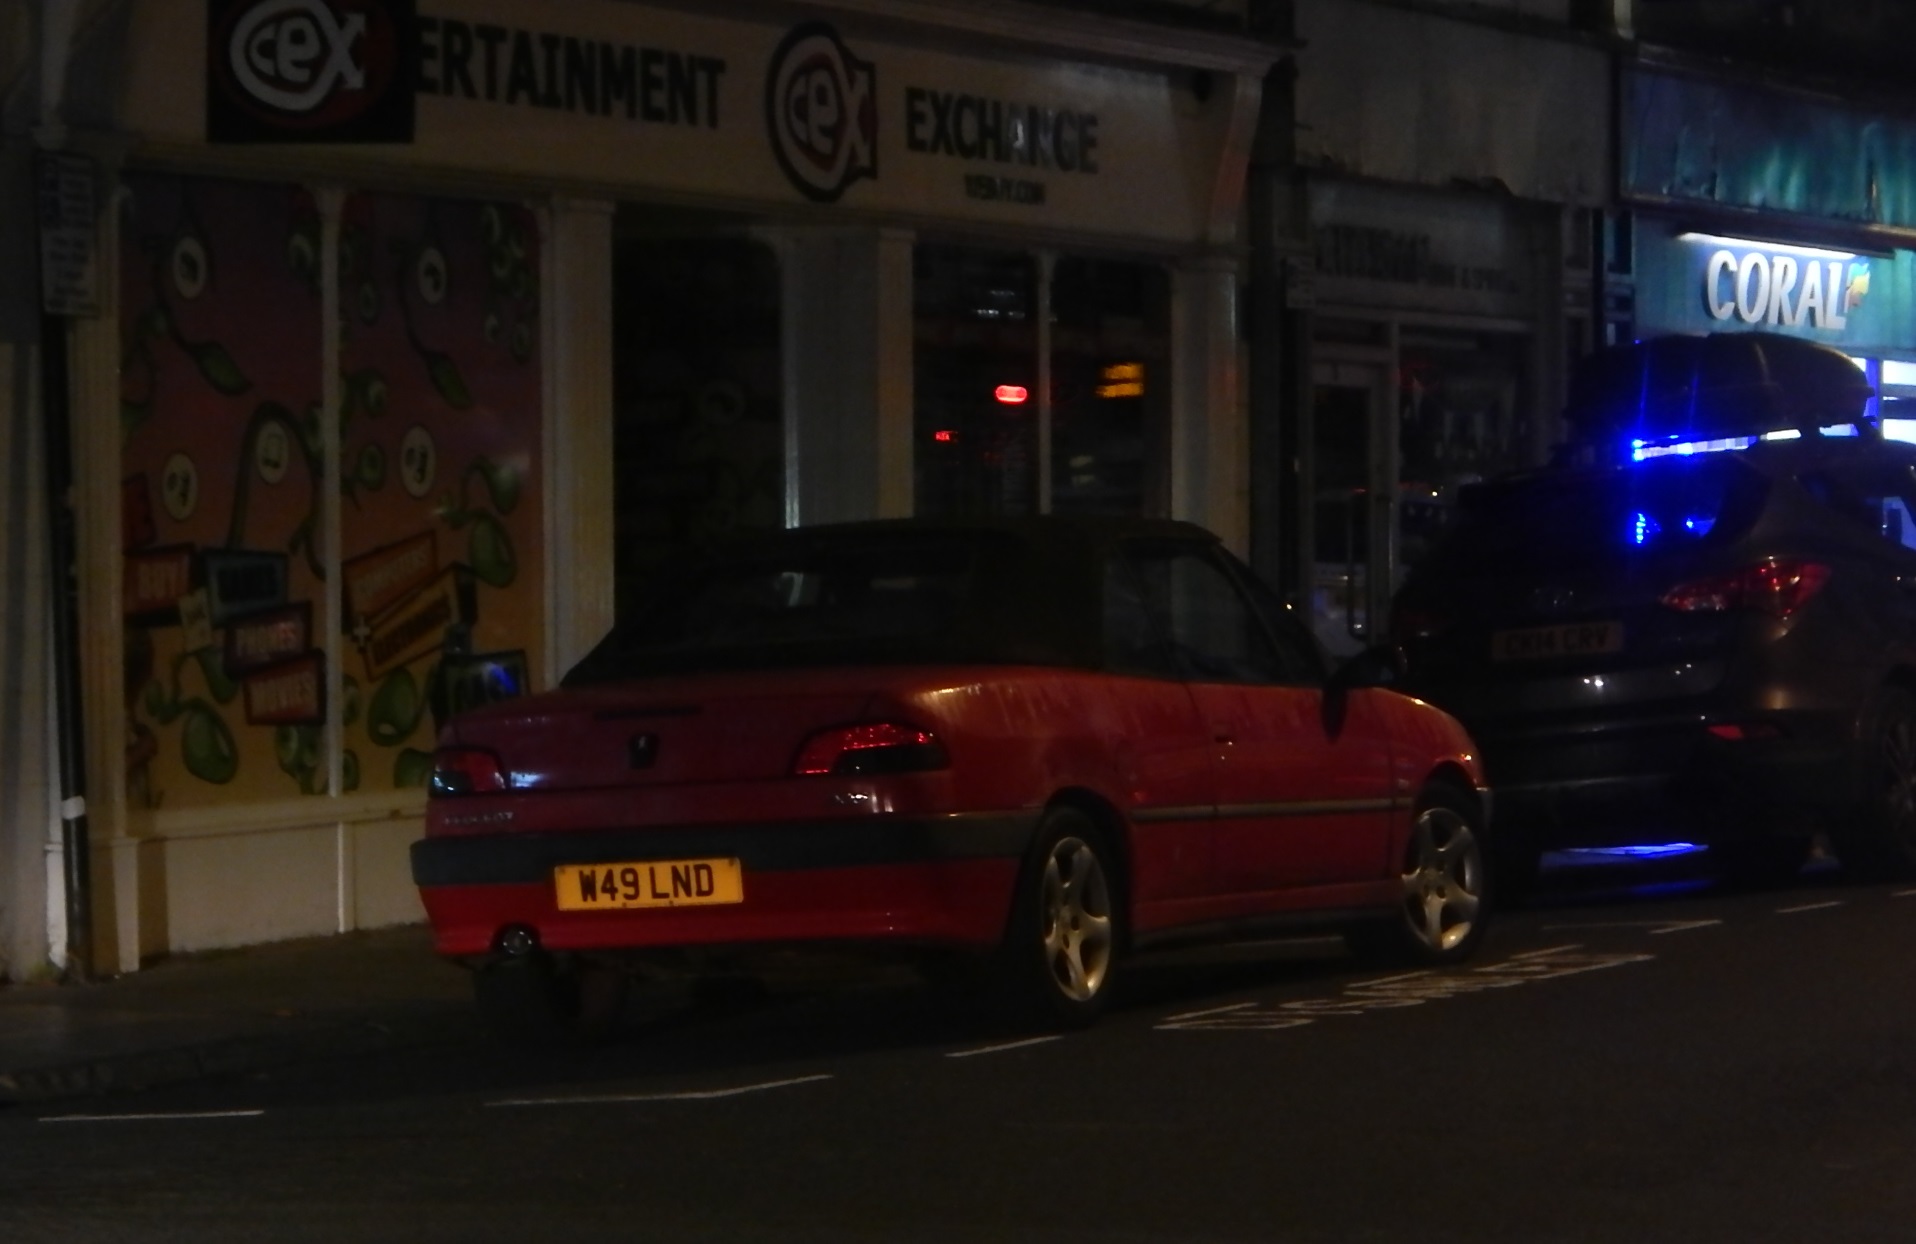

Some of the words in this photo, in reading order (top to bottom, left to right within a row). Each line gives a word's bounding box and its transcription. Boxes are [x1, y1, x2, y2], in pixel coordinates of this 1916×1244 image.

[415, 15, 725, 130] ERTAINMENT
[905, 86, 1099, 175] EXCHANGE
[1706, 250, 1848, 331] CORAL
[580, 867, 641, 902] W49
[650, 863, 715, 900] LND
